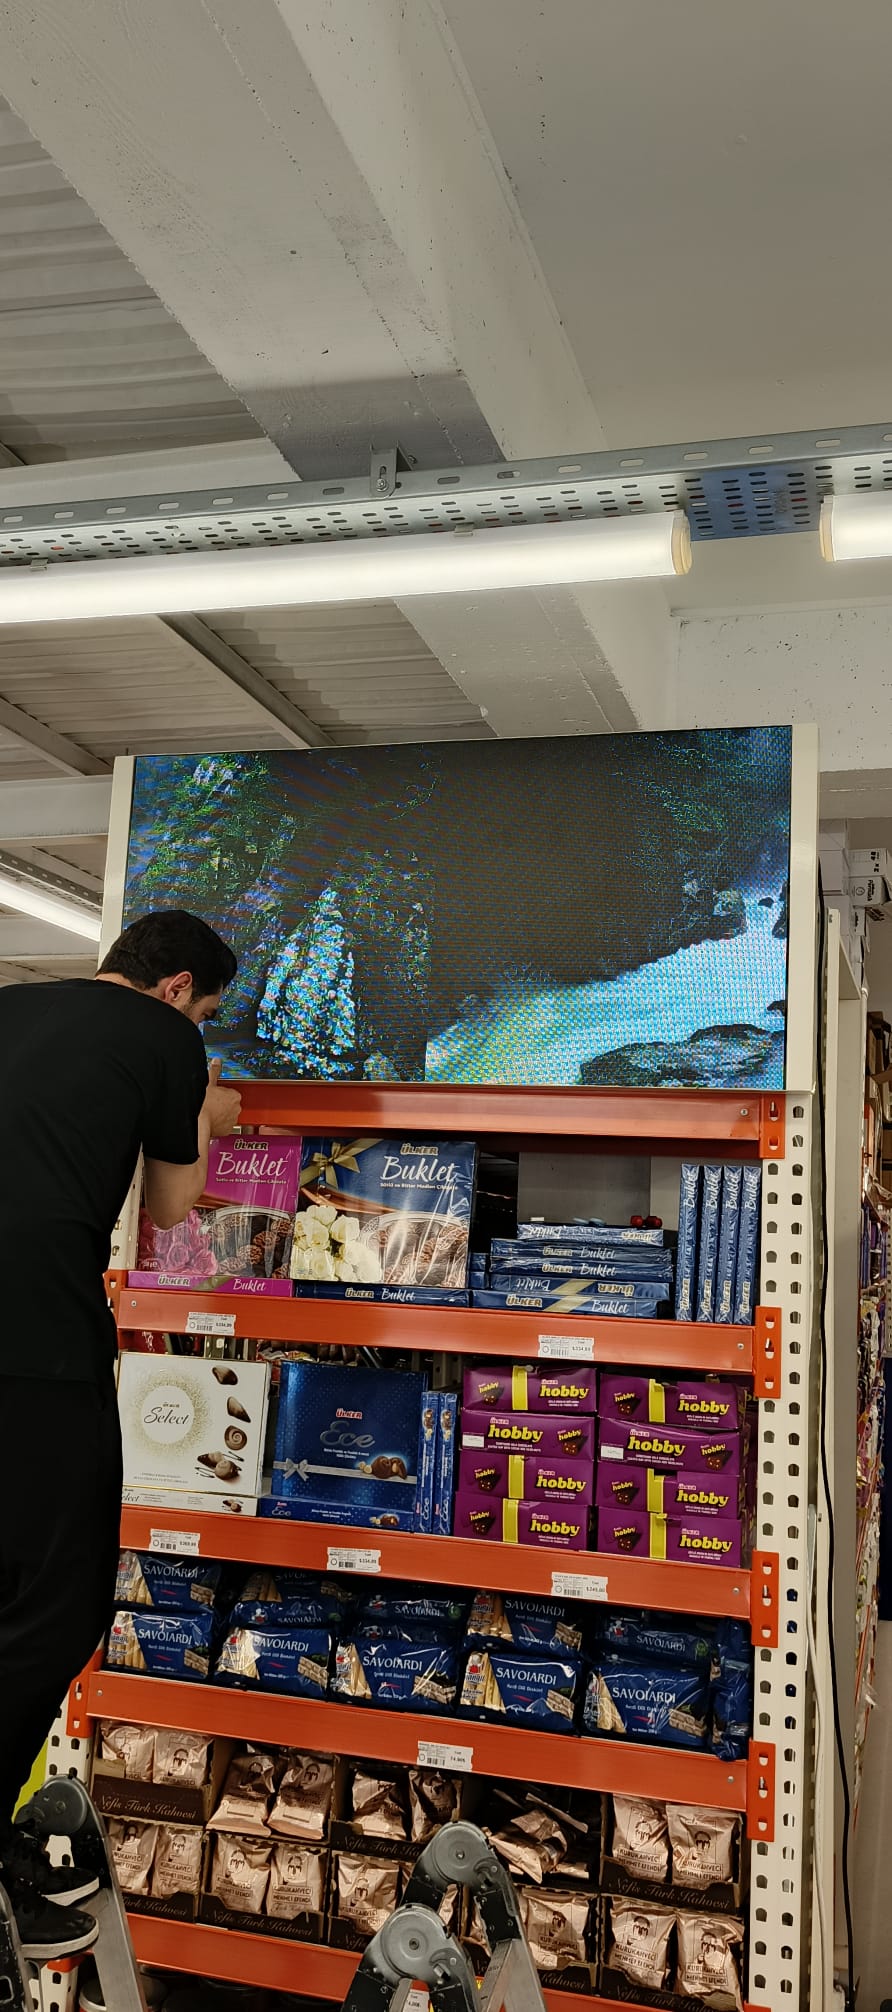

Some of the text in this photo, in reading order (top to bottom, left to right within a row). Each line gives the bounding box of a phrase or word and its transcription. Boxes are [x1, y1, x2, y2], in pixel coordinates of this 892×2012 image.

[234, 1138, 268, 1151] ÜLKER
[401, 1143, 438, 1155] ÜLKER
[216, 1151, 288, 1177] Buklet
[380, 1155, 459, 1182] Buklet
[683, 1172, 697, 1208] Buklet
[706, 1173, 718, 1208] Buklet
[726, 1174, 739, 1210] Buklet
[745, 1175, 758, 1210] Buklet
[580, 1246, 615, 1259] Buklet
[542, 1263, 616, 1276] ÜLKER Buklet
[158, 1274, 265, 1291] ÜLKER Buklet
[516, 1278, 635, 1297] ÜLKER Buklet
[382, 1287, 415, 1302] Buklet
[506, 1294, 629, 1313] ÜLKER Buklet
[540, 1385, 589, 1399] hobby
[144, 1407, 189, 1424] Select
[336, 1408, 363, 1419] ÜLKER
[678, 1400, 730, 1415] hobby
[320, 1421, 375, 1447] Ece
[488, 1424, 543, 1442] hobby
[558, 1429, 582, 1441] hobby
[628, 1436, 686, 1457] hobby
[701, 1444, 726, 1455] hobby
[536, 1476, 587, 1492] hobby
[677, 1490, 729, 1507] hobby
[530, 1520, 580, 1536] hobby
[680, 1534, 732, 1552] hobby
[144, 1565, 198, 1578] SAVOIARDI
[505, 1599, 565, 1617] SAVOIARDI
[138, 1628, 192, 1645] SAVOIARDI
[253, 1636, 309, 1653] SAVOIARDI
[636, 1633, 686, 1652] SAVOIARDI
[363, 1656, 422, 1671] SAVOIARDI
[496, 1667, 557, 1685] SAVOIARDI
[612, 1687, 676, 1703] SAVOIARDI
[124, 1800, 151, 1813] Türk
